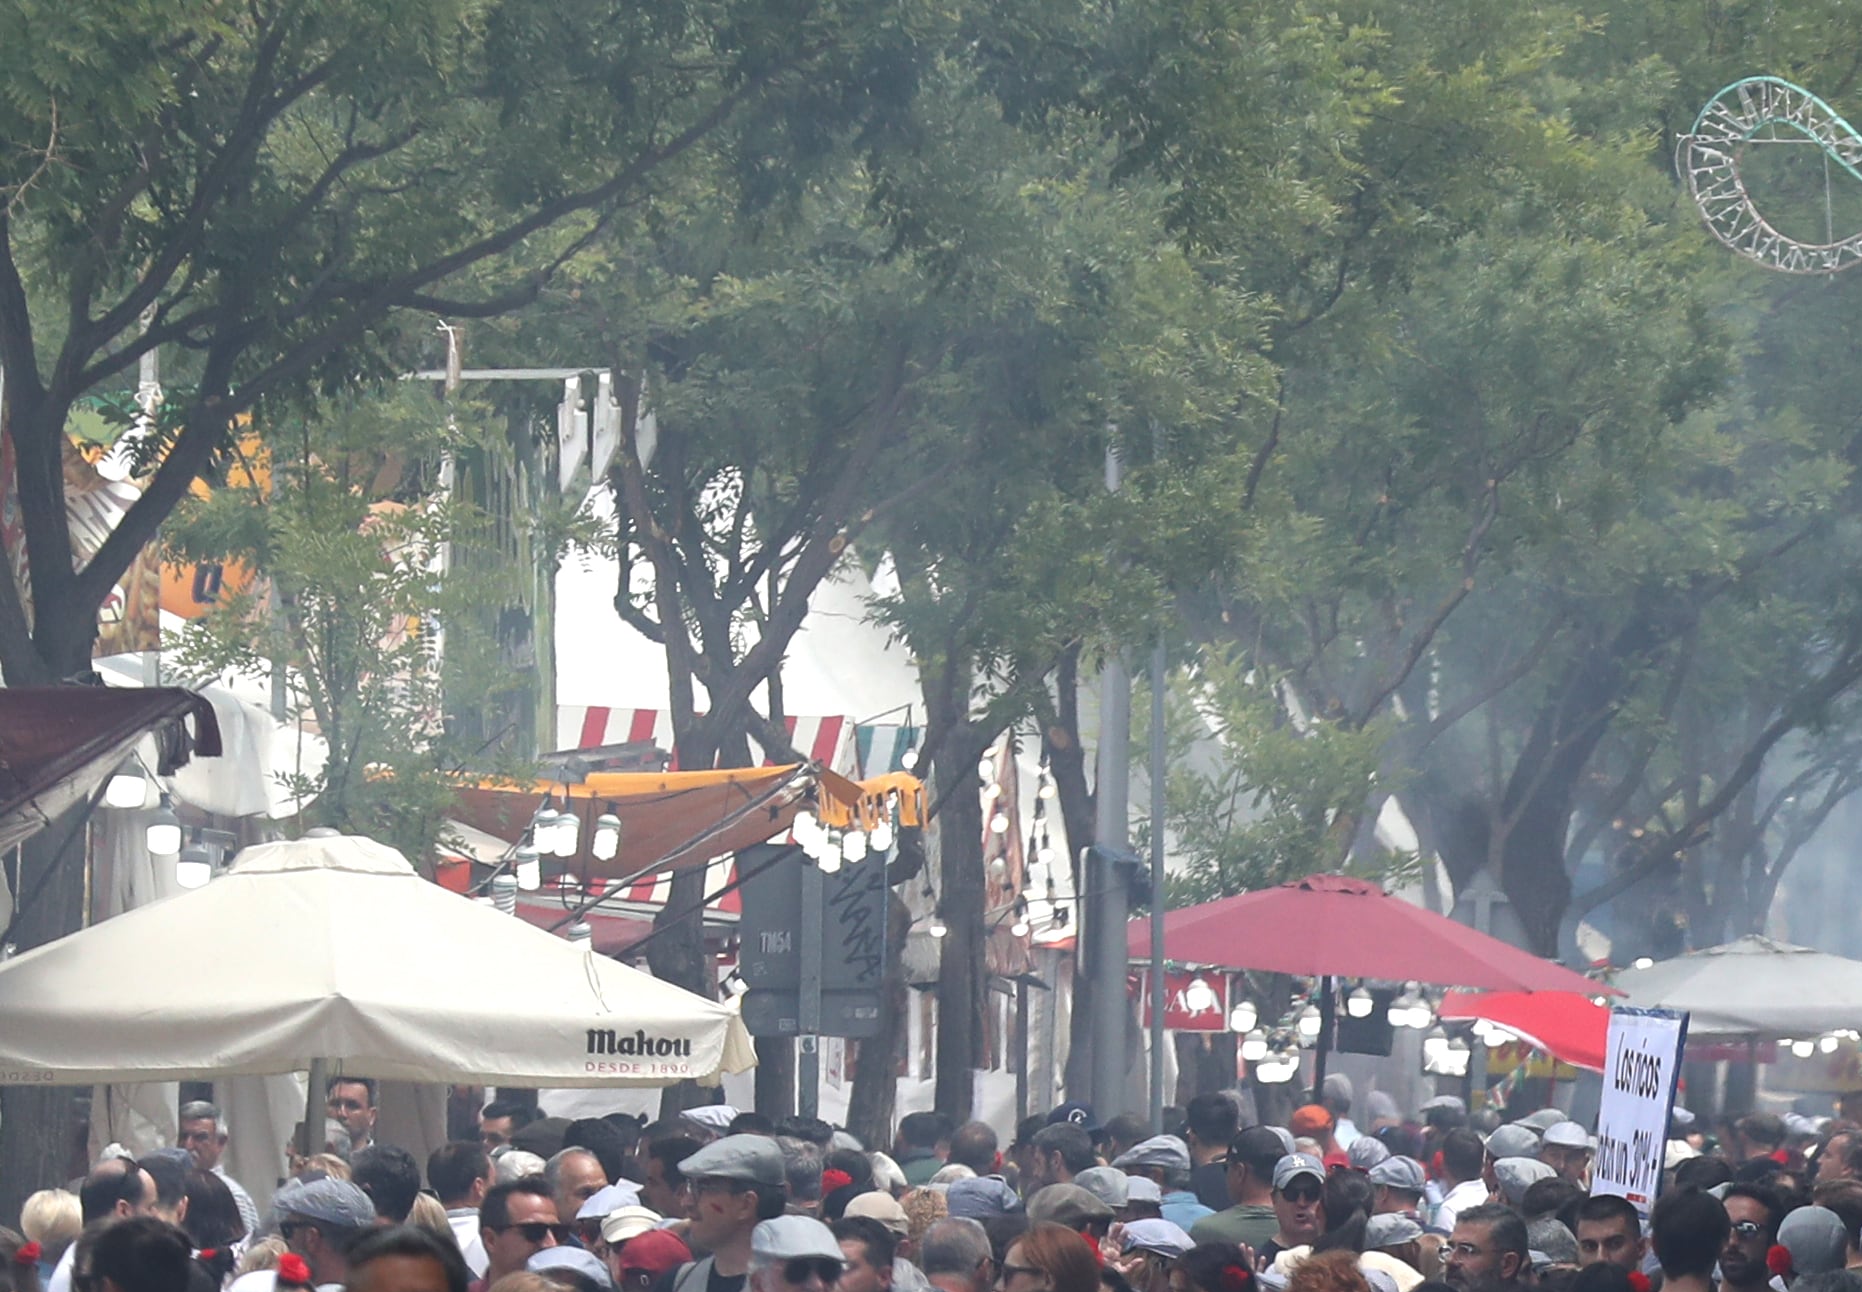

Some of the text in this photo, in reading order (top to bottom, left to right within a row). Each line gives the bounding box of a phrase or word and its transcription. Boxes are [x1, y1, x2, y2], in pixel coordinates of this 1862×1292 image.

[586, 1028, 691, 1057] Mahou
[585, 1061, 641, 1074] DESDE
[1615, 1032, 1634, 1091] Los
